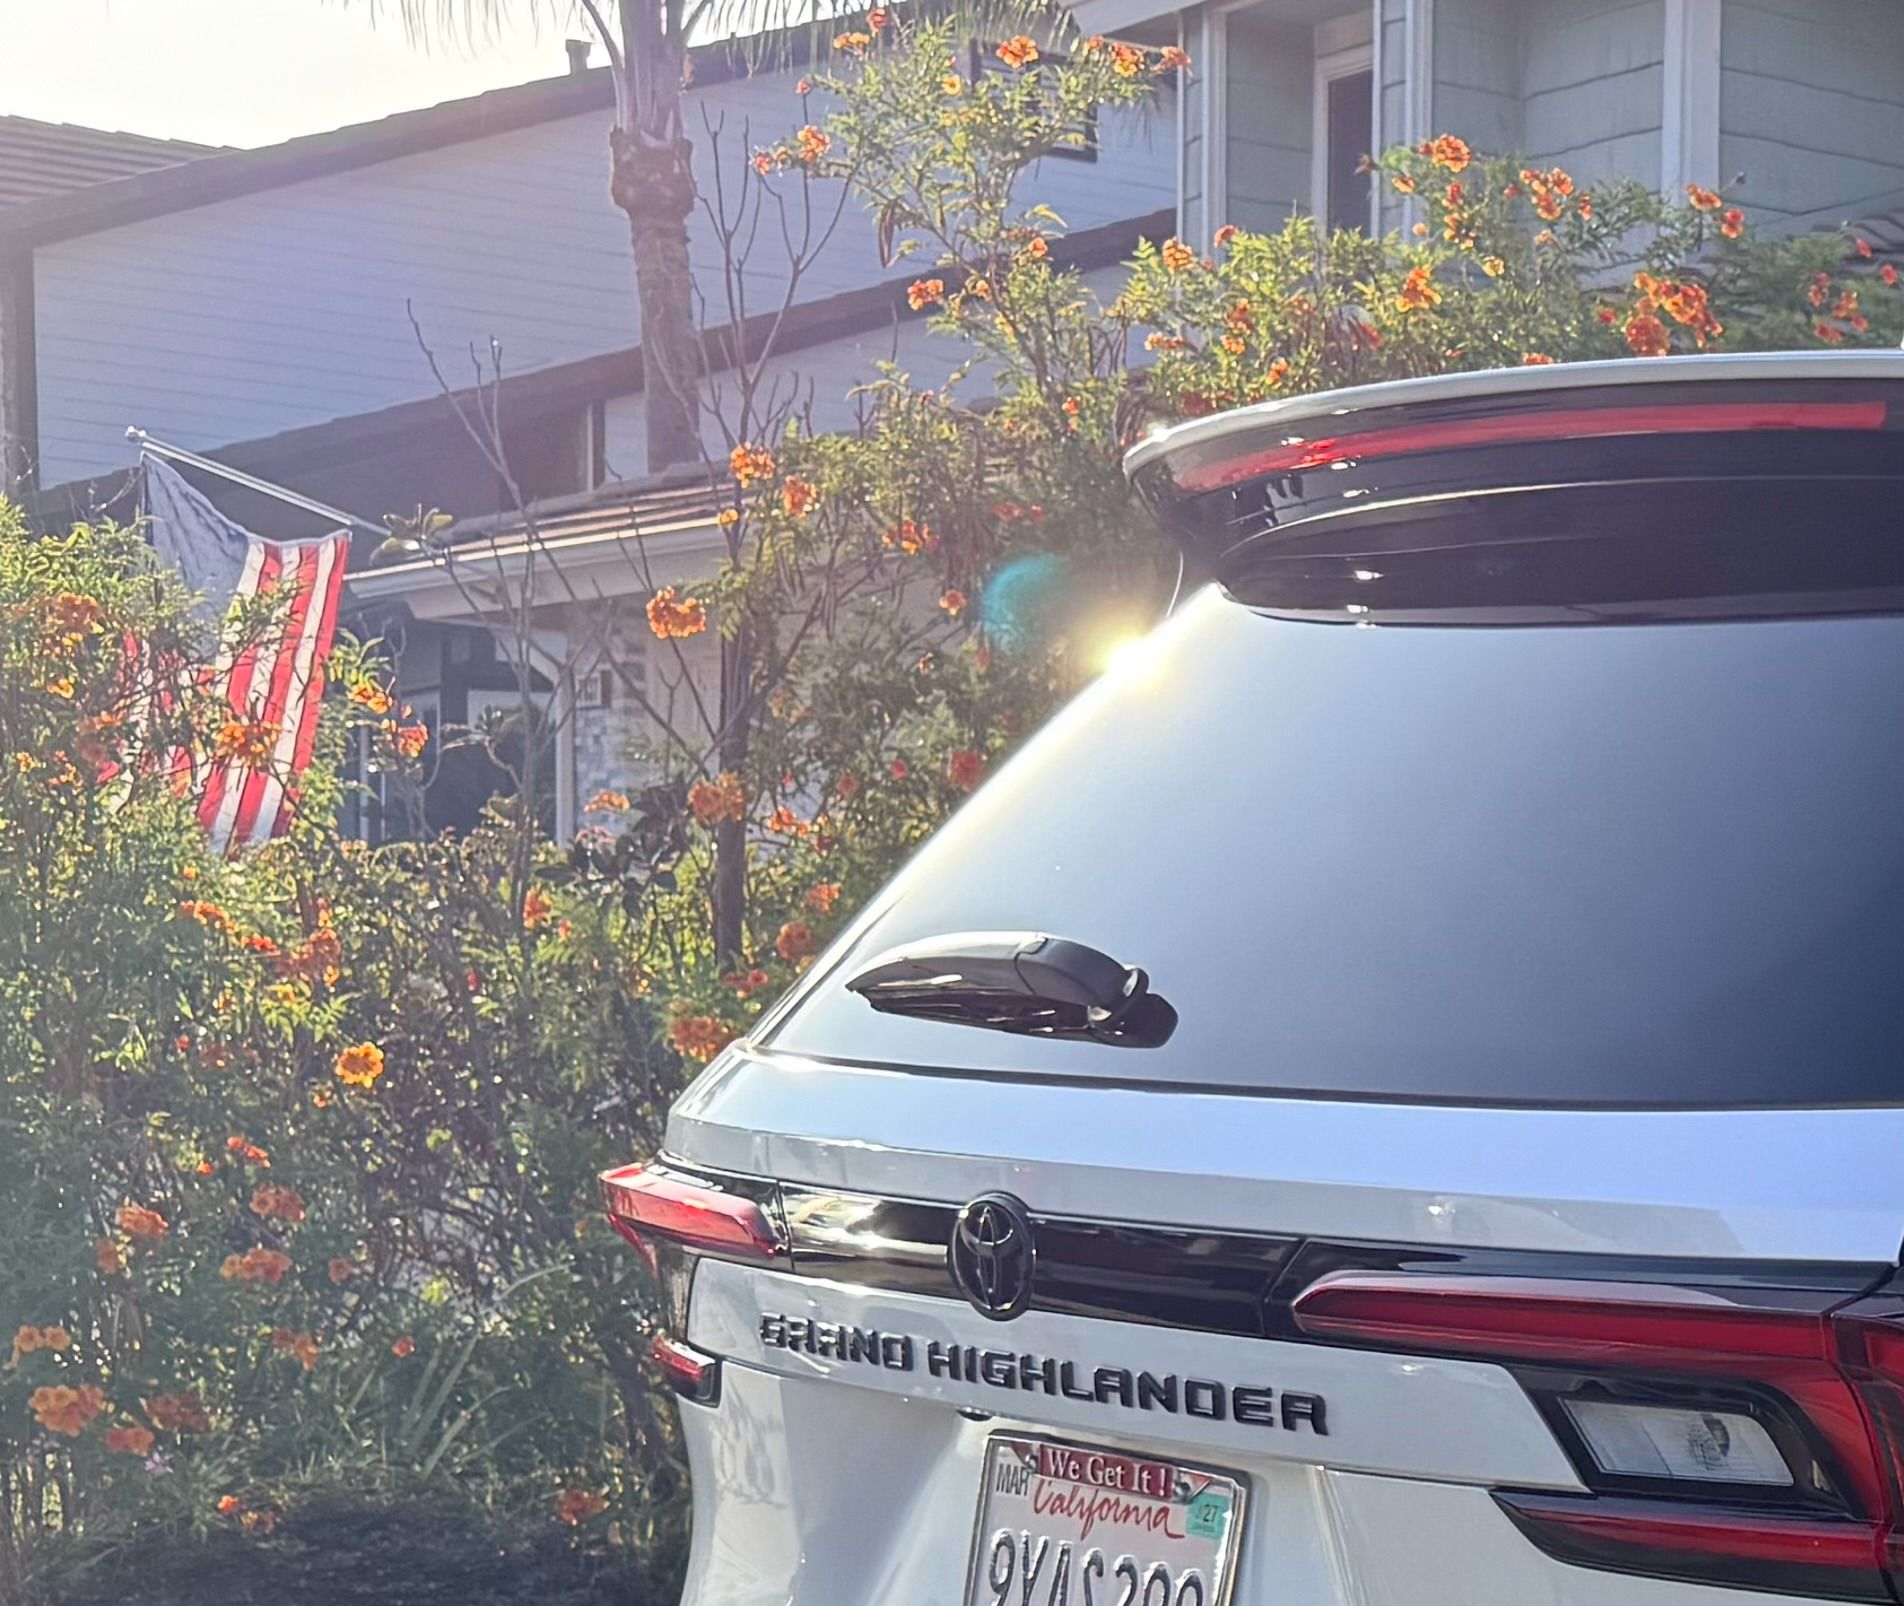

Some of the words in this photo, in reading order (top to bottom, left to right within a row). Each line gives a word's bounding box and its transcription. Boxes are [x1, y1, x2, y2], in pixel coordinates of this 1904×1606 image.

[927, 1339, 1330, 1437] HIGHLANDER
[996, 1463, 1029, 1497] MAR
[1048, 1447, 1080, 1480] We
[1086, 1455, 1125, 1489] Get
[1033, 1479, 1185, 1540] California
